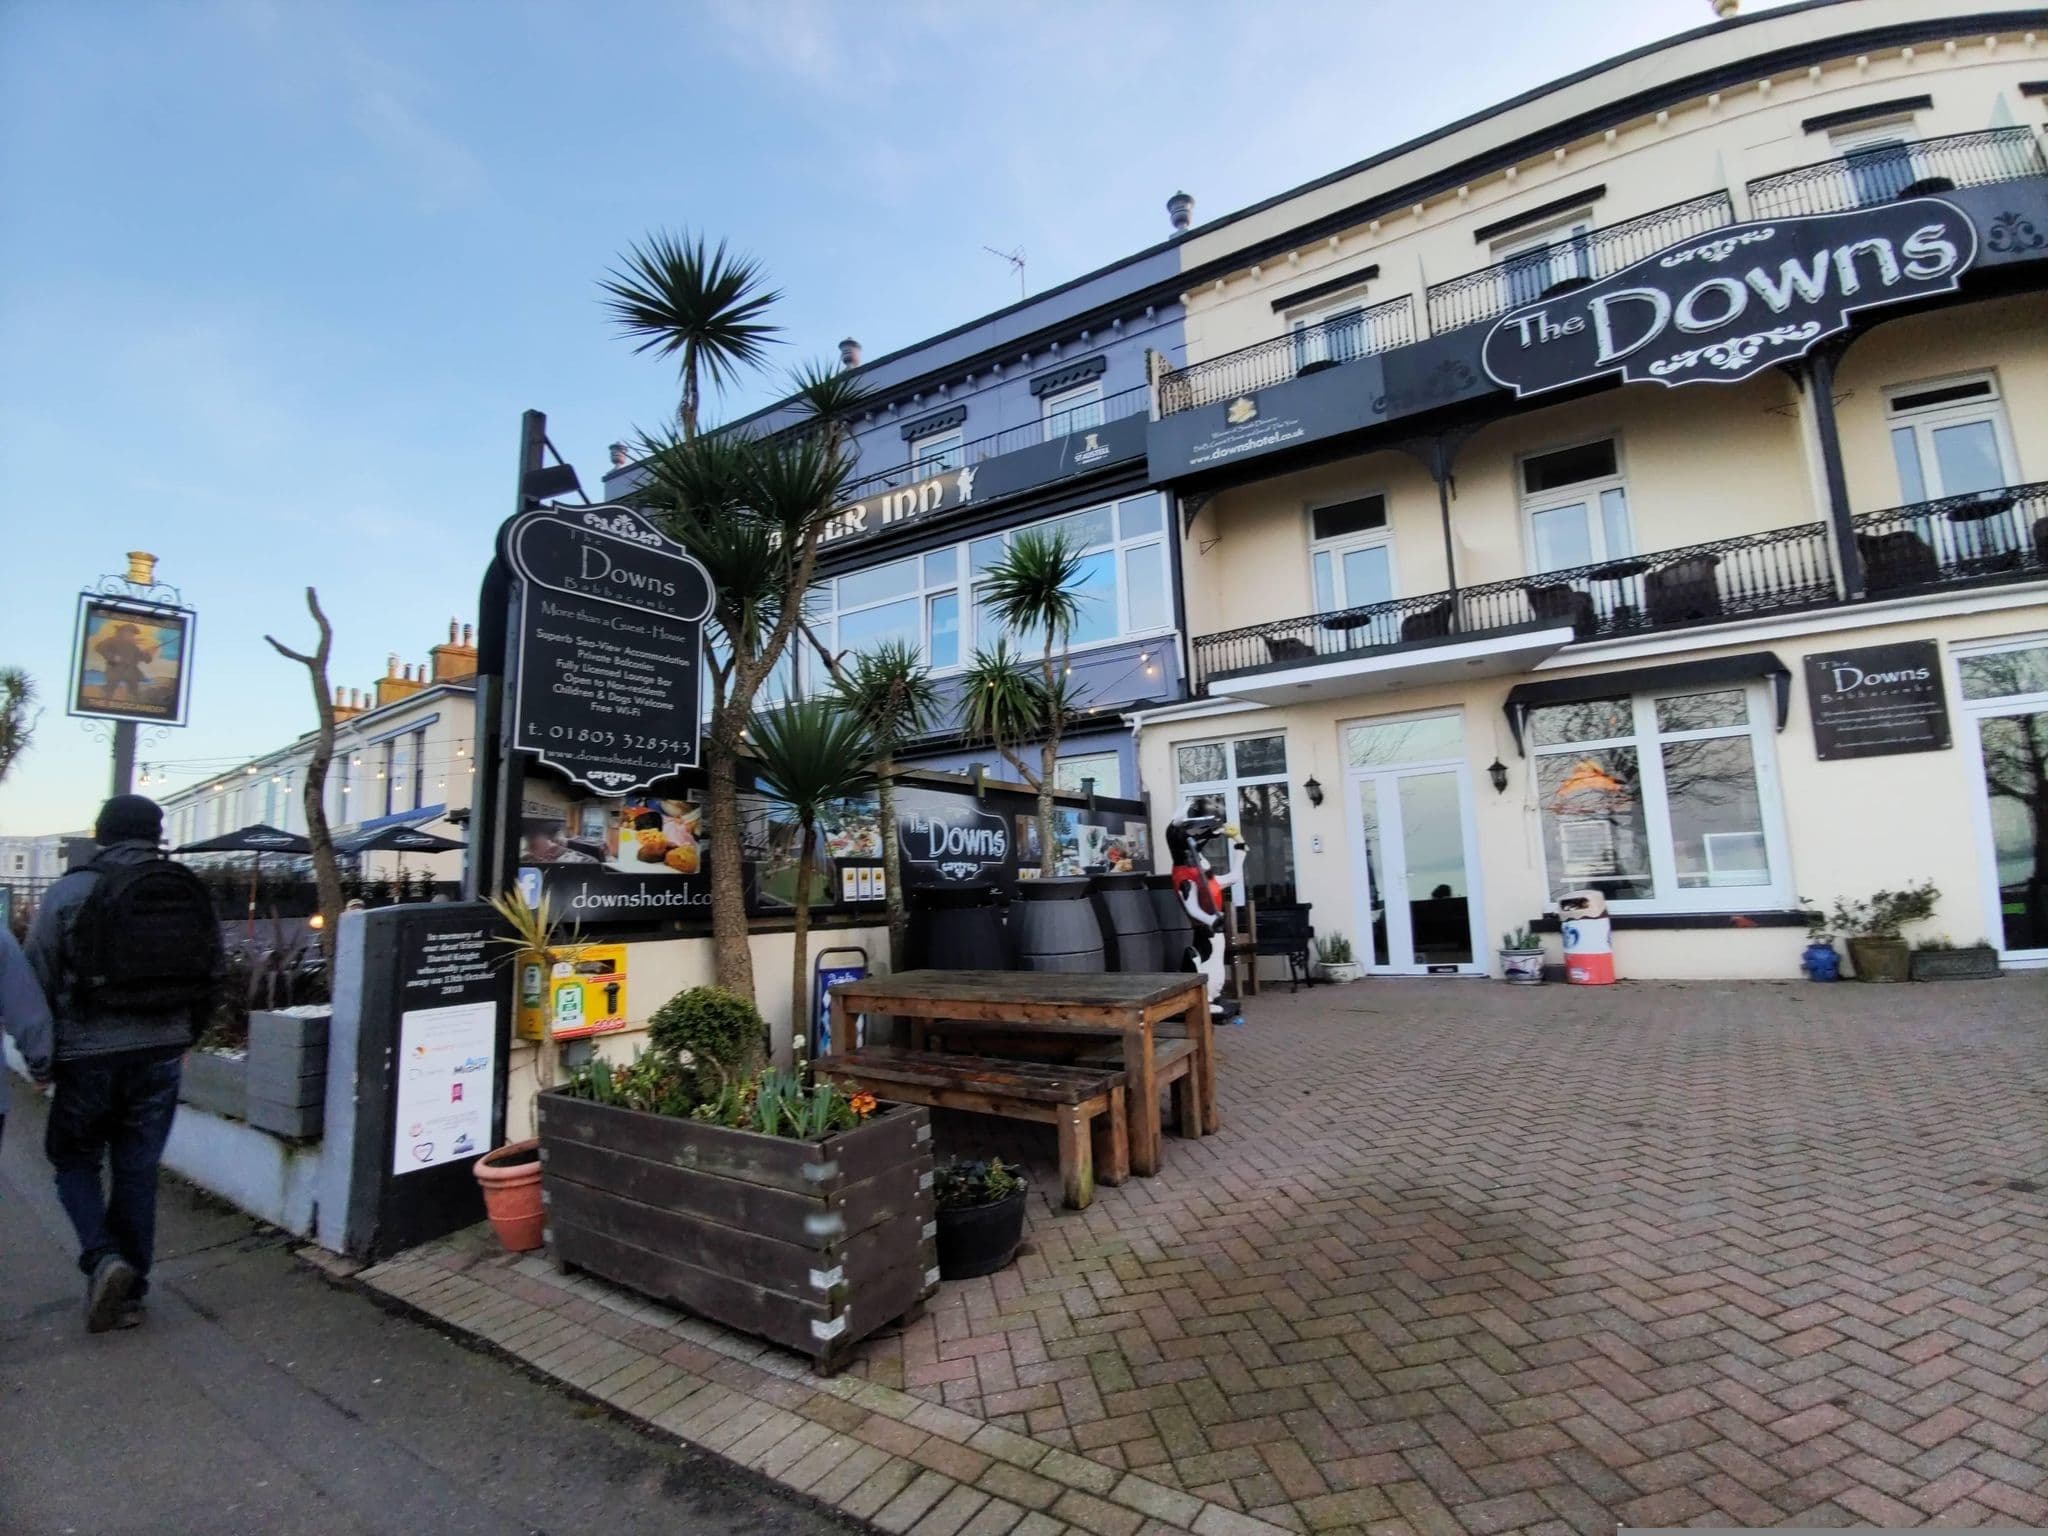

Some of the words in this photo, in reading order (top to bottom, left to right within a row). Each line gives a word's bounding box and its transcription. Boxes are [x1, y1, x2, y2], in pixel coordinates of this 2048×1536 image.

[1504, 309, 1586, 350] The
[1586, 223, 1959, 368] Downs
[570, 528, 602, 546] The
[580, 544, 676, 597] Downs
[541, 600, 575, 618] More
[576, 609, 601, 624] than
[536, 628, 574, 644] Superb
[624, 646, 691, 667] Accommodation
[577, 649, 612, 664] Private
[614, 656, 656, 672] Balconies
[556, 658, 581, 673] Fully
[582, 663, 622, 678] Licensed
[623, 670, 656, 686] Lounge
[657, 676, 673, 687] Bar
[562, 672, 592, 686] Open
[594, 678, 605, 687] to
[1832, 667, 1930, 693] Downs
[552, 683, 595, 698] Children
[596, 690, 606, 700] &
[608, 691, 632, 705] Dogs
[633, 695, 675, 710] Welcome
[590, 701, 613, 713] Free
[549, 725, 616, 747] 01803
[623, 733, 691, 756] 328543
[928, 816, 1005, 858] Downs
